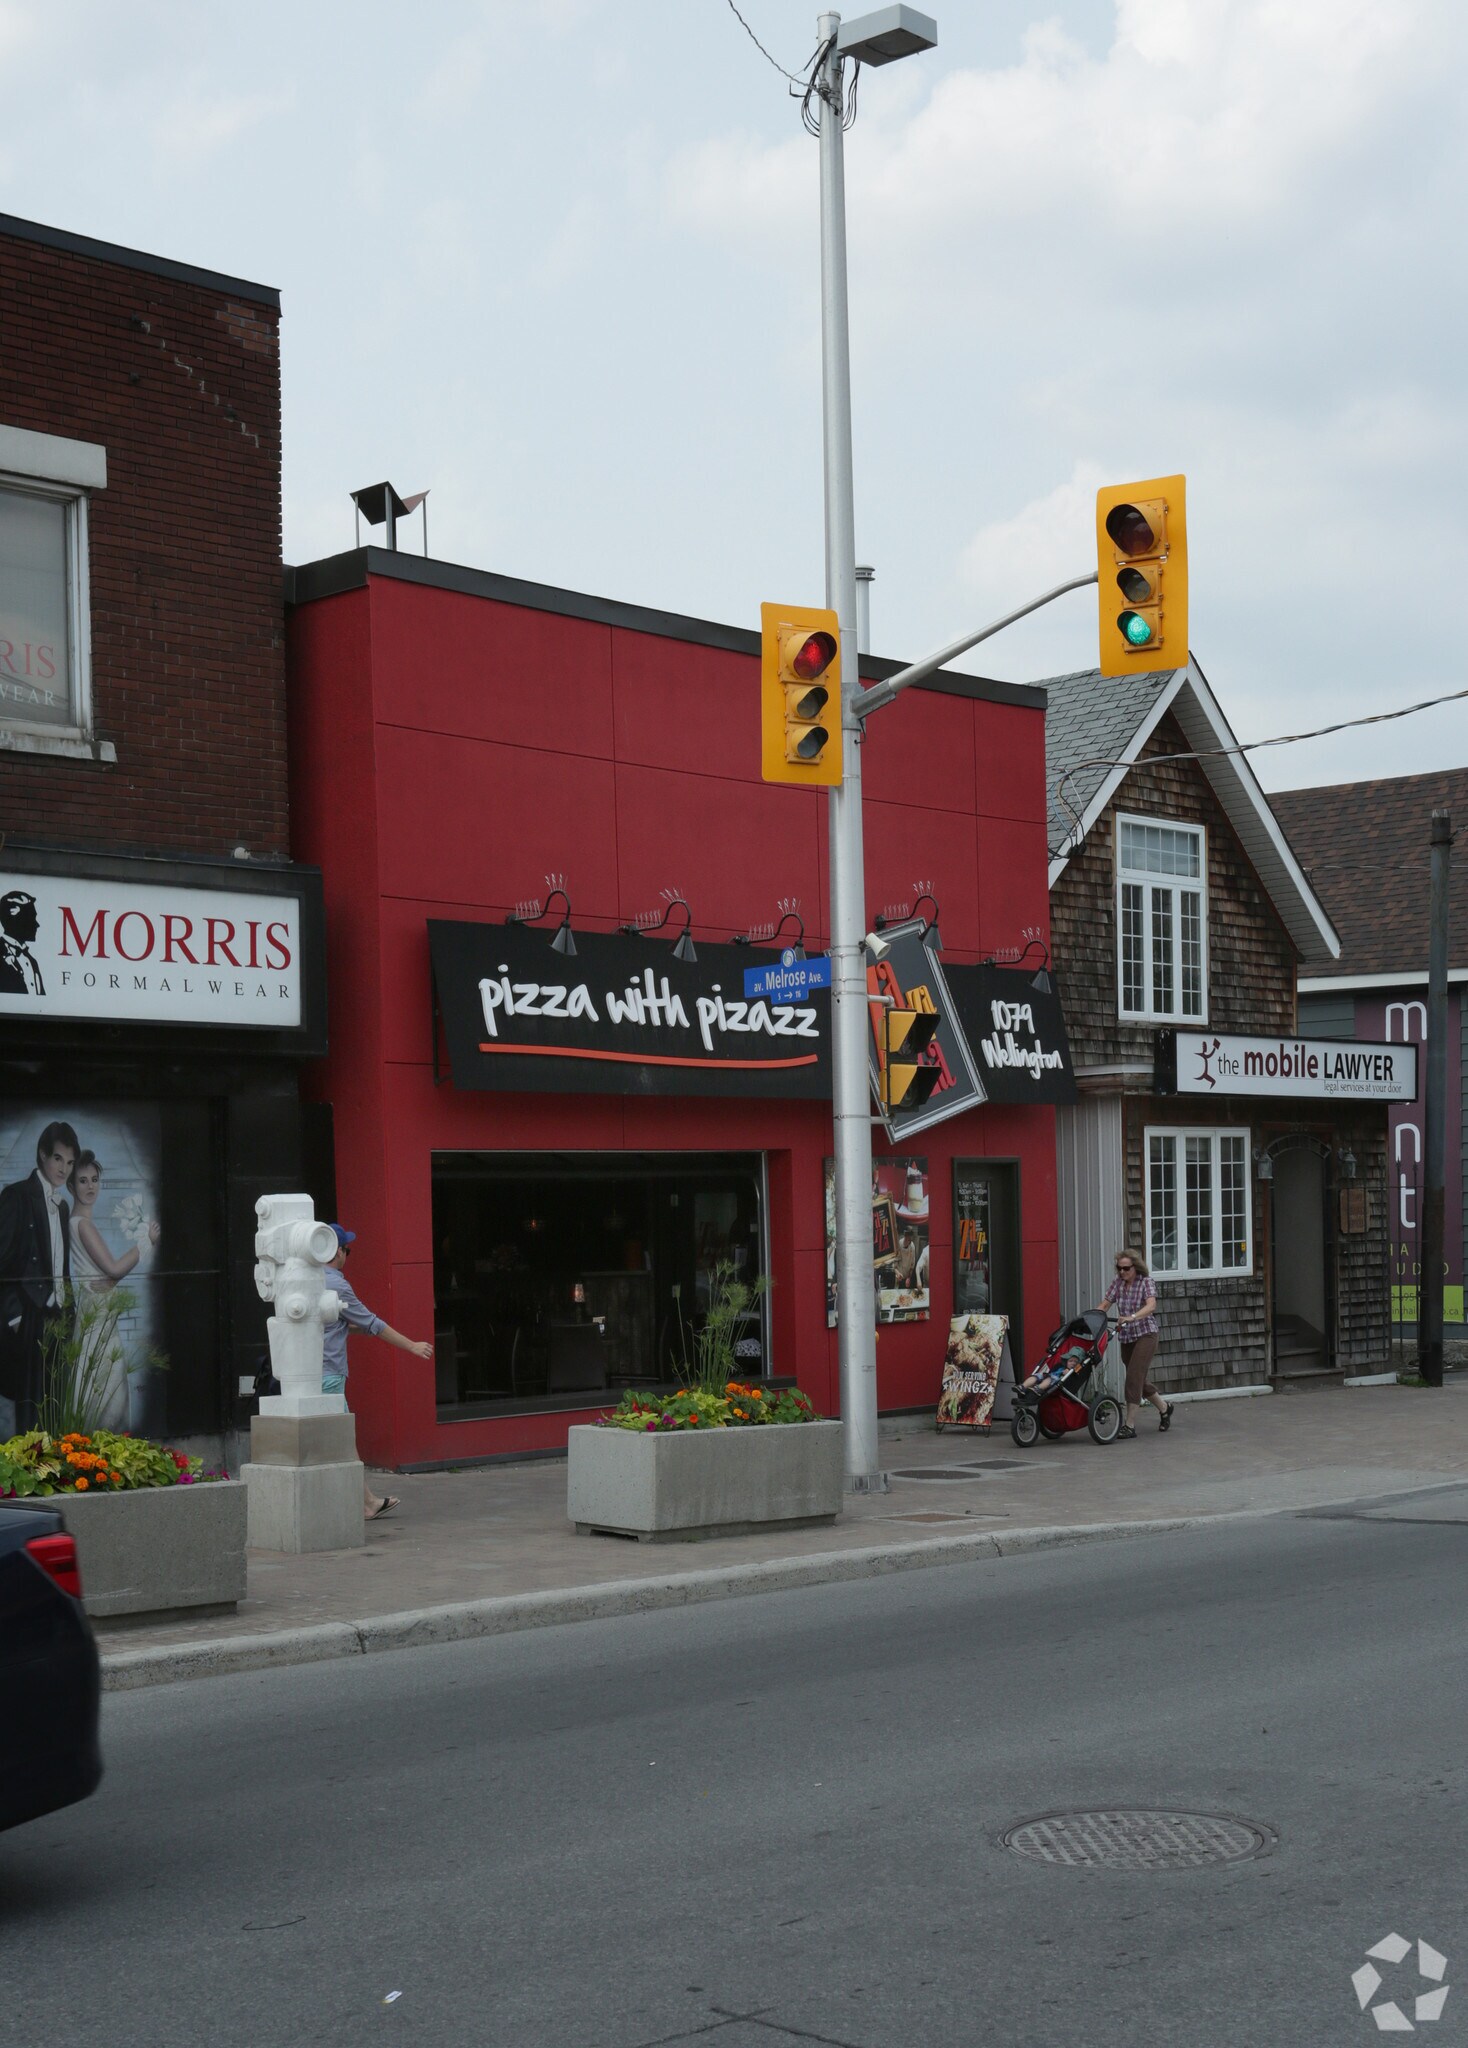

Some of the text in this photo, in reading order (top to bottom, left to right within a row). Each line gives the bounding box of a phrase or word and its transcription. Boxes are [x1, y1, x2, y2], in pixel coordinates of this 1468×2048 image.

[57, 906, 291, 970] MORRIS
[753, 968, 823, 992] av. Melrose Ave.
[478, 964, 820, 1051] pizza with pizazz
[991, 1000, 1035, 1034] 1079
[981, 1031, 1064, 1080] Wellington
[1217, 1043, 1394, 1082] the mobile LAWYER
[1323, 1080, 1402, 1096] legal services at your door
[949, 1380, 988, 1394] WINGZ
[964, 1371, 987, 1381] SERVING
